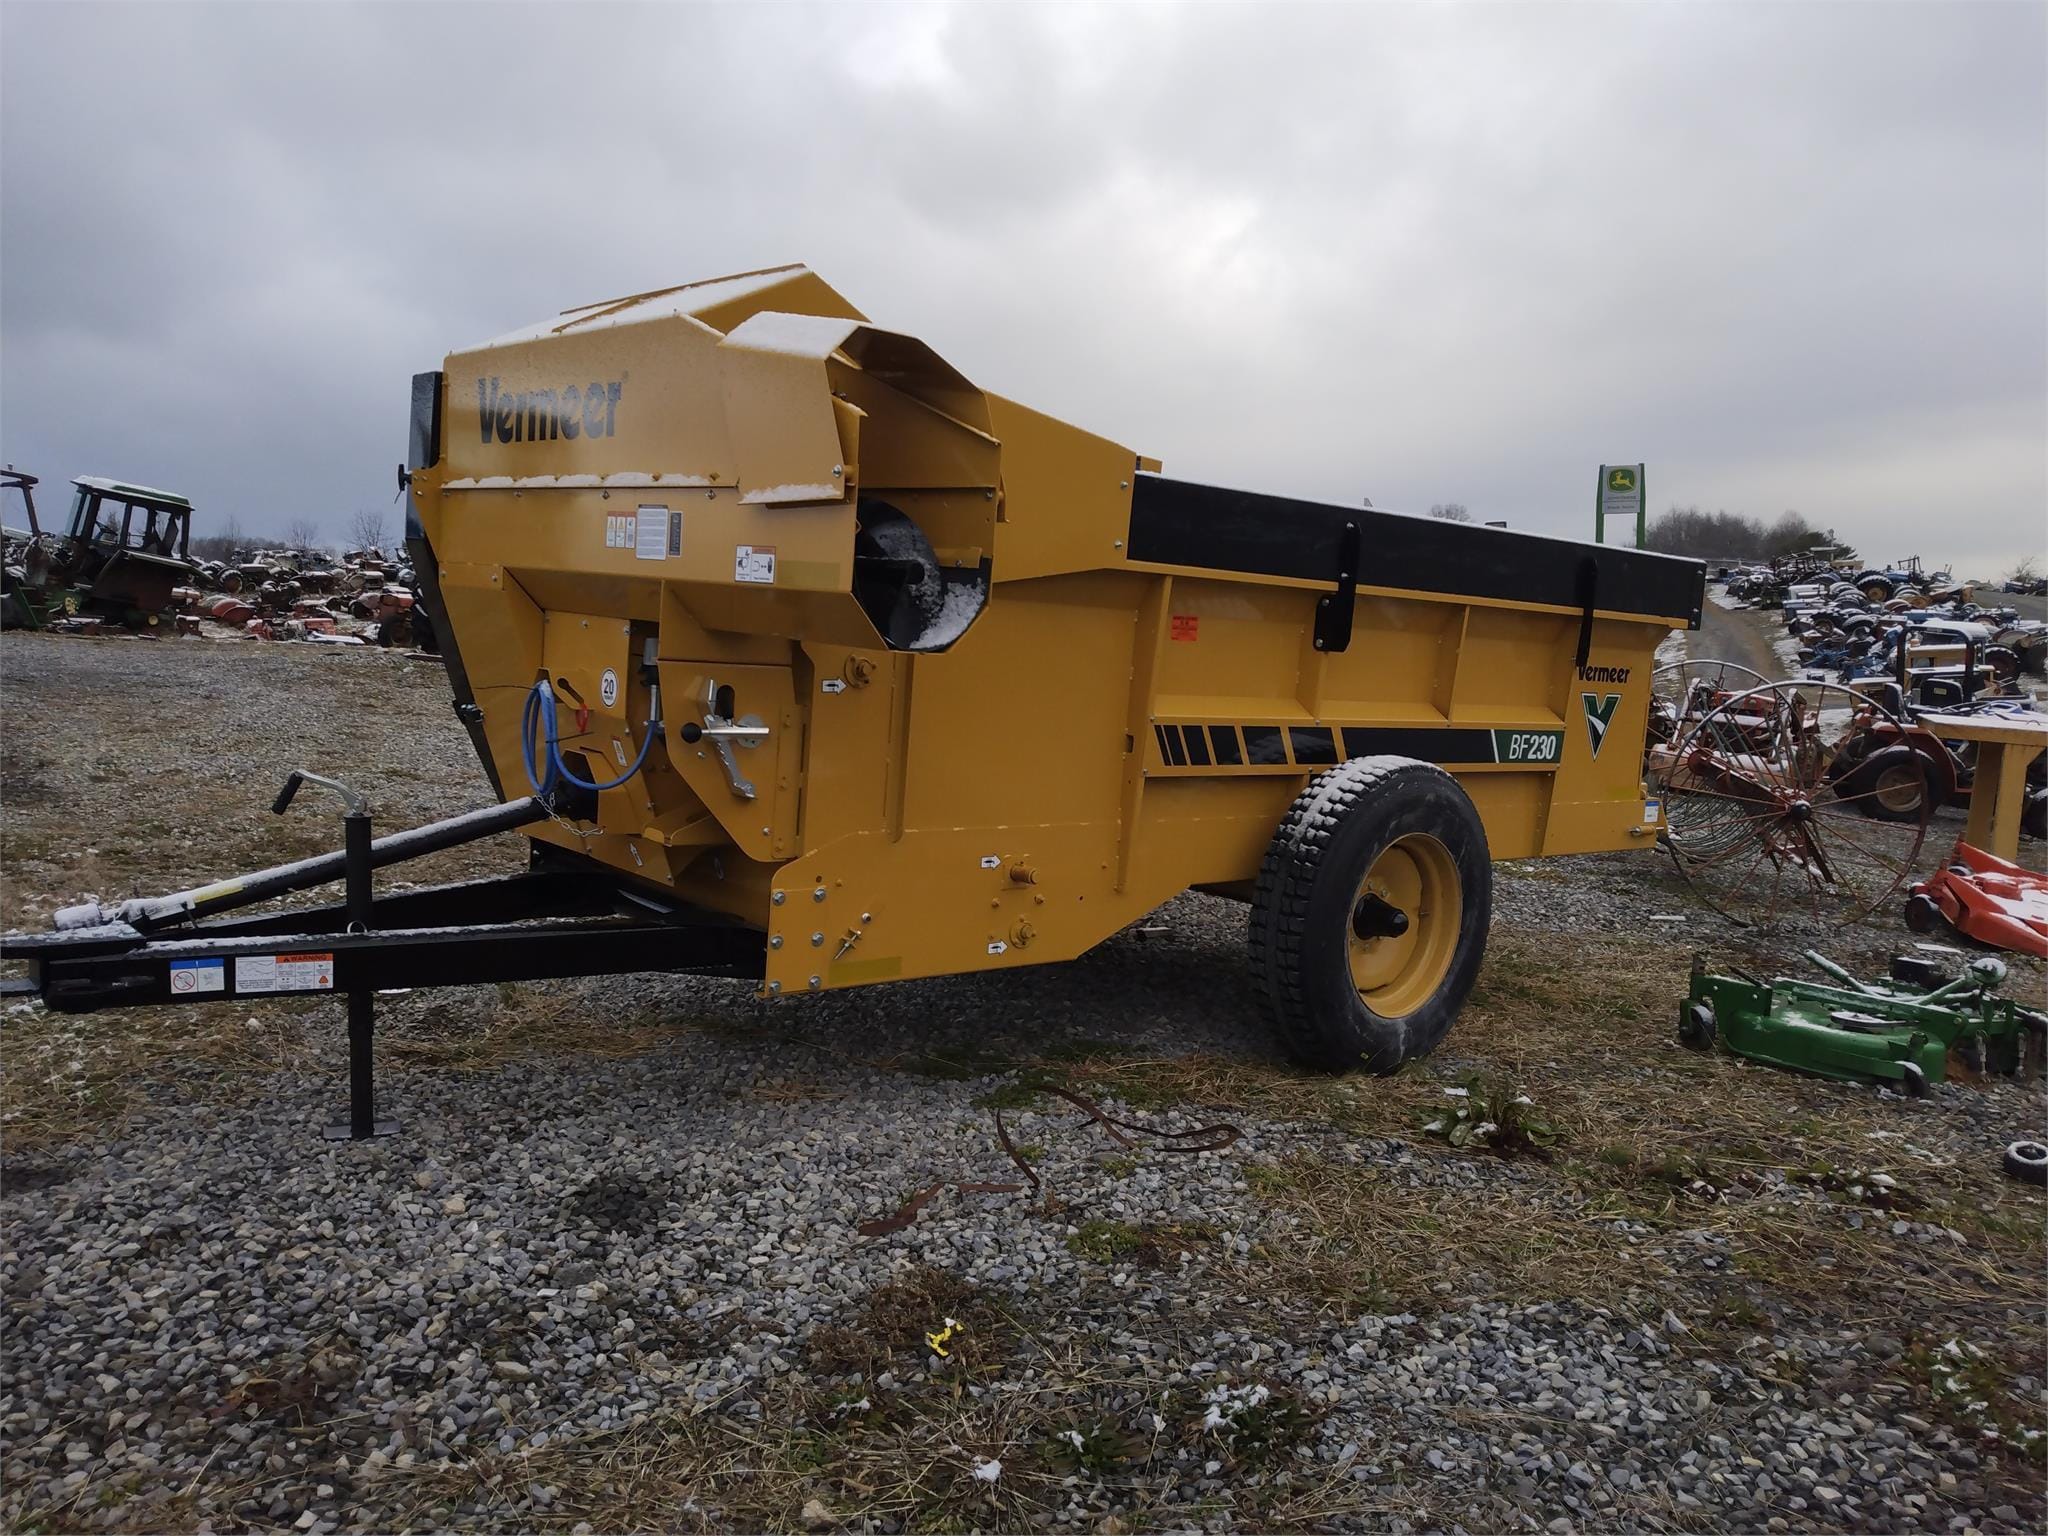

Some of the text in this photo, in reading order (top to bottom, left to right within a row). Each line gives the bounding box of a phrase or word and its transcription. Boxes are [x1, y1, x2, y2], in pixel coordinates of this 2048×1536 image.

[478, 376, 621, 443] Vermeer
[1578, 665, 1630, 683] Vermeer
[604, 678, 614, 695] 20
[1509, 734, 1557, 760] BF230
[292, 954, 327, 962] WARNING
